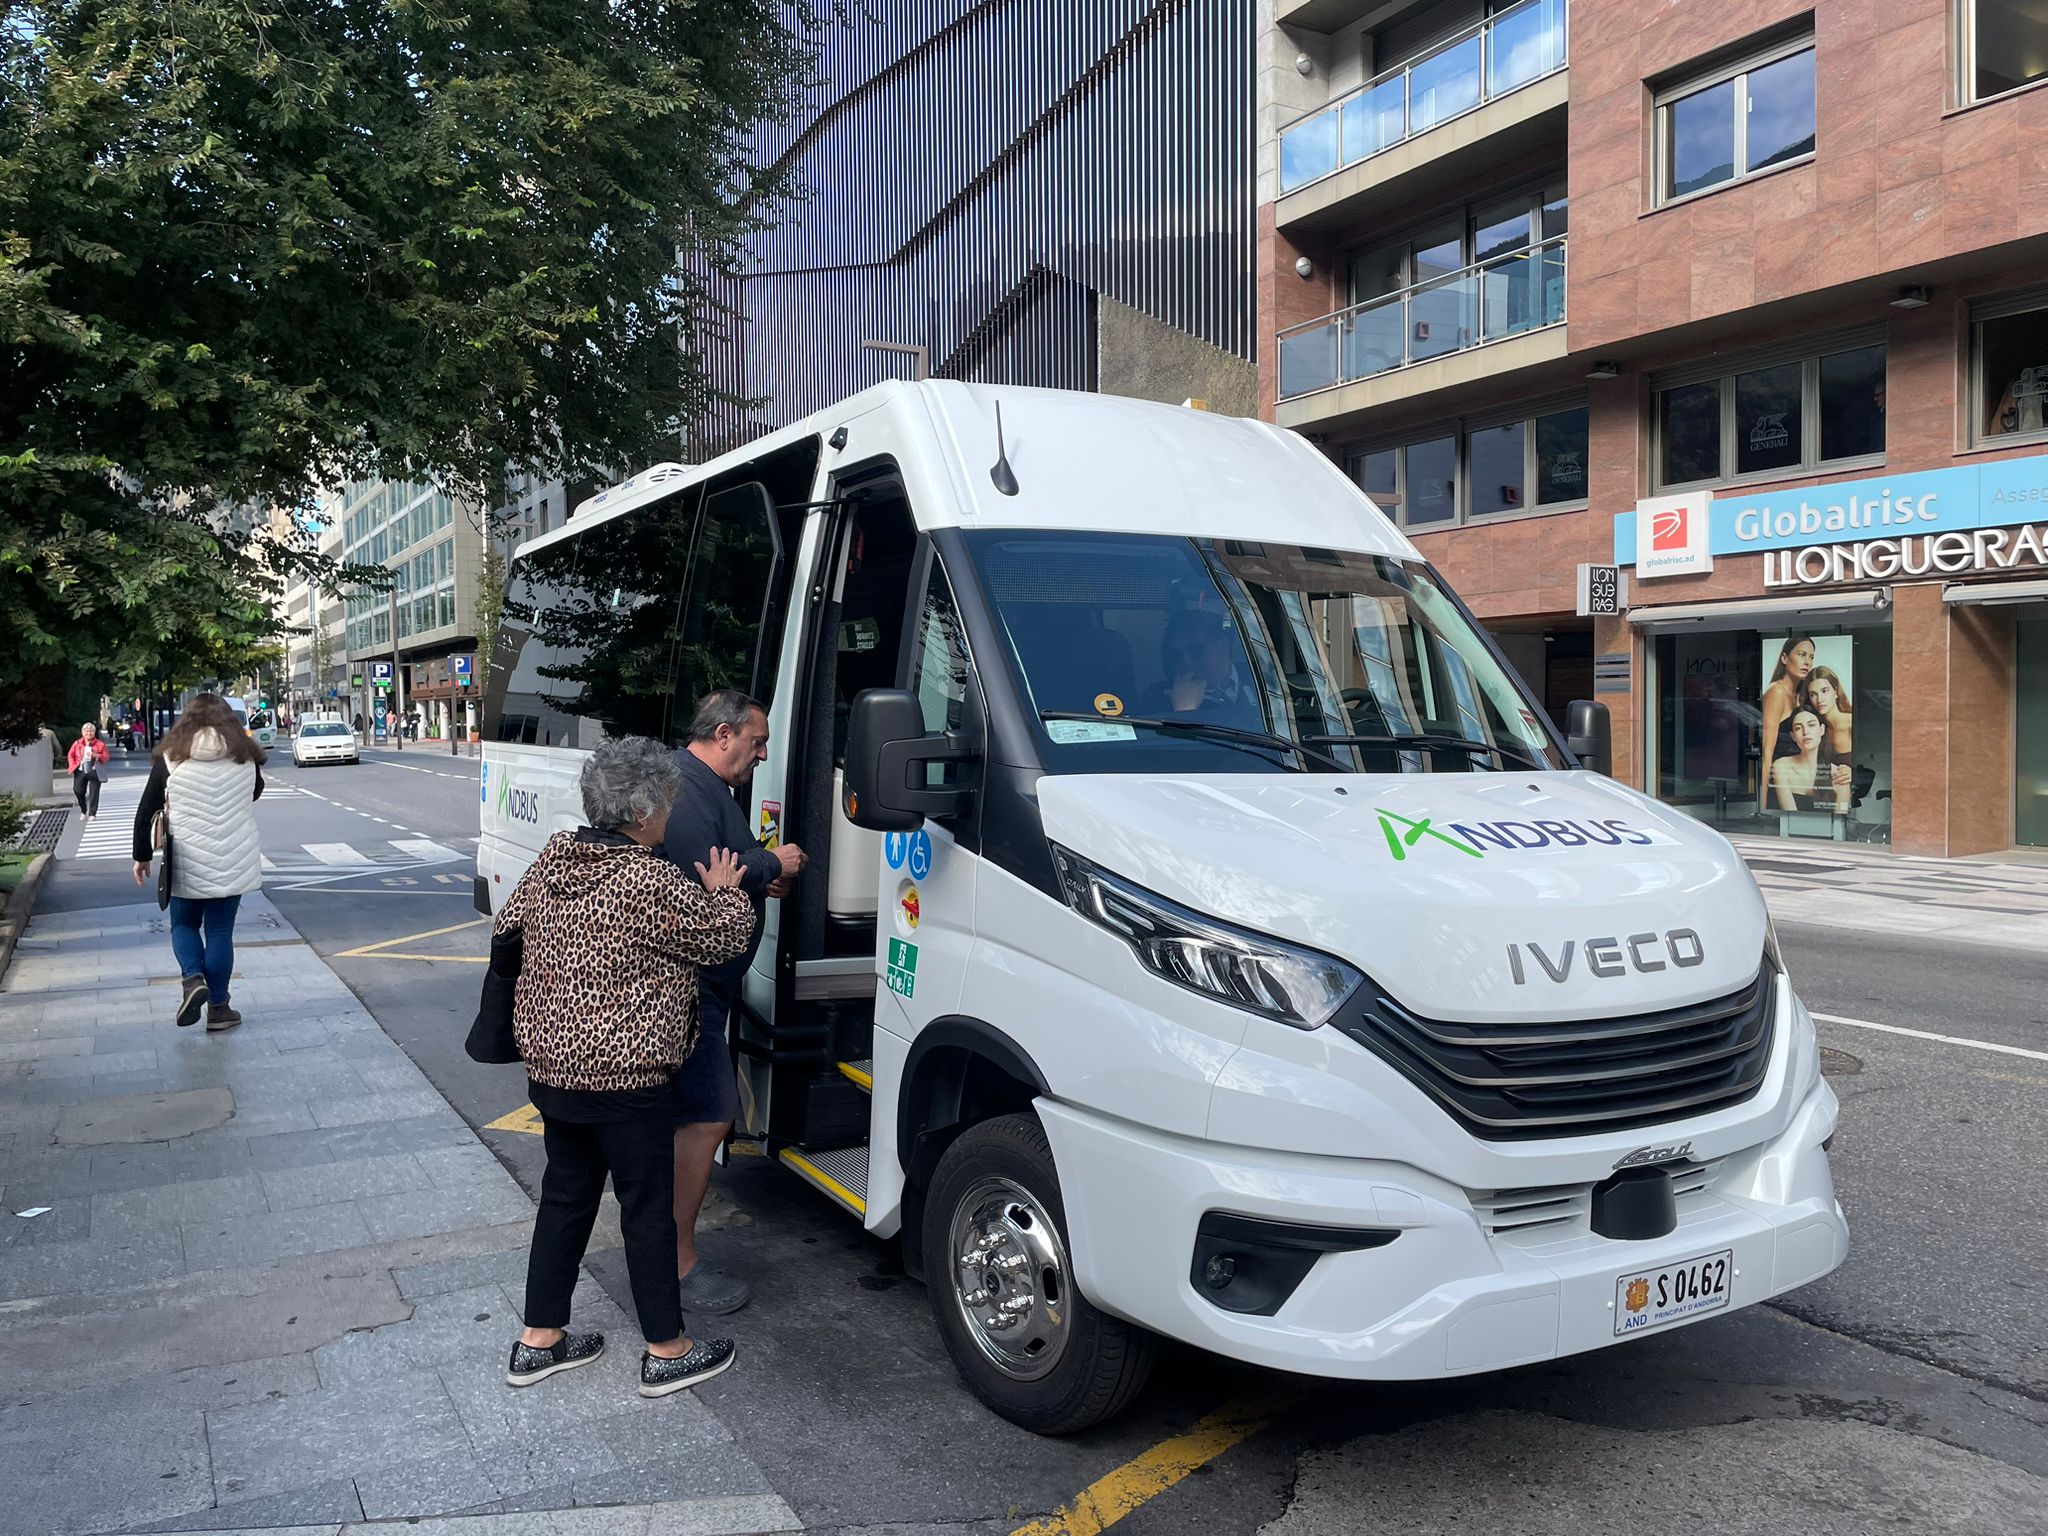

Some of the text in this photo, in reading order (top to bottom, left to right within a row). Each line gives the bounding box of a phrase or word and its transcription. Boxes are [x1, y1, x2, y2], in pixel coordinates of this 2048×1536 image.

[1750, 437, 1788, 451] GENERALI
[1735, 488, 1938, 541] Globalrisc
[1646, 554, 1695, 568] globalrisc.ad
[1764, 525, 2048, 587] LLONGUERA
[375, 664, 388, 677] P
[455, 657, 465, 674] P
[1506, 928, 1705, 985] IVECO
[1656, 1259, 1726, 1308] S 0462
[1654, 1305, 1687, 1320] PRINCIPAT
[1624, 1314, 1648, 1329] AND
